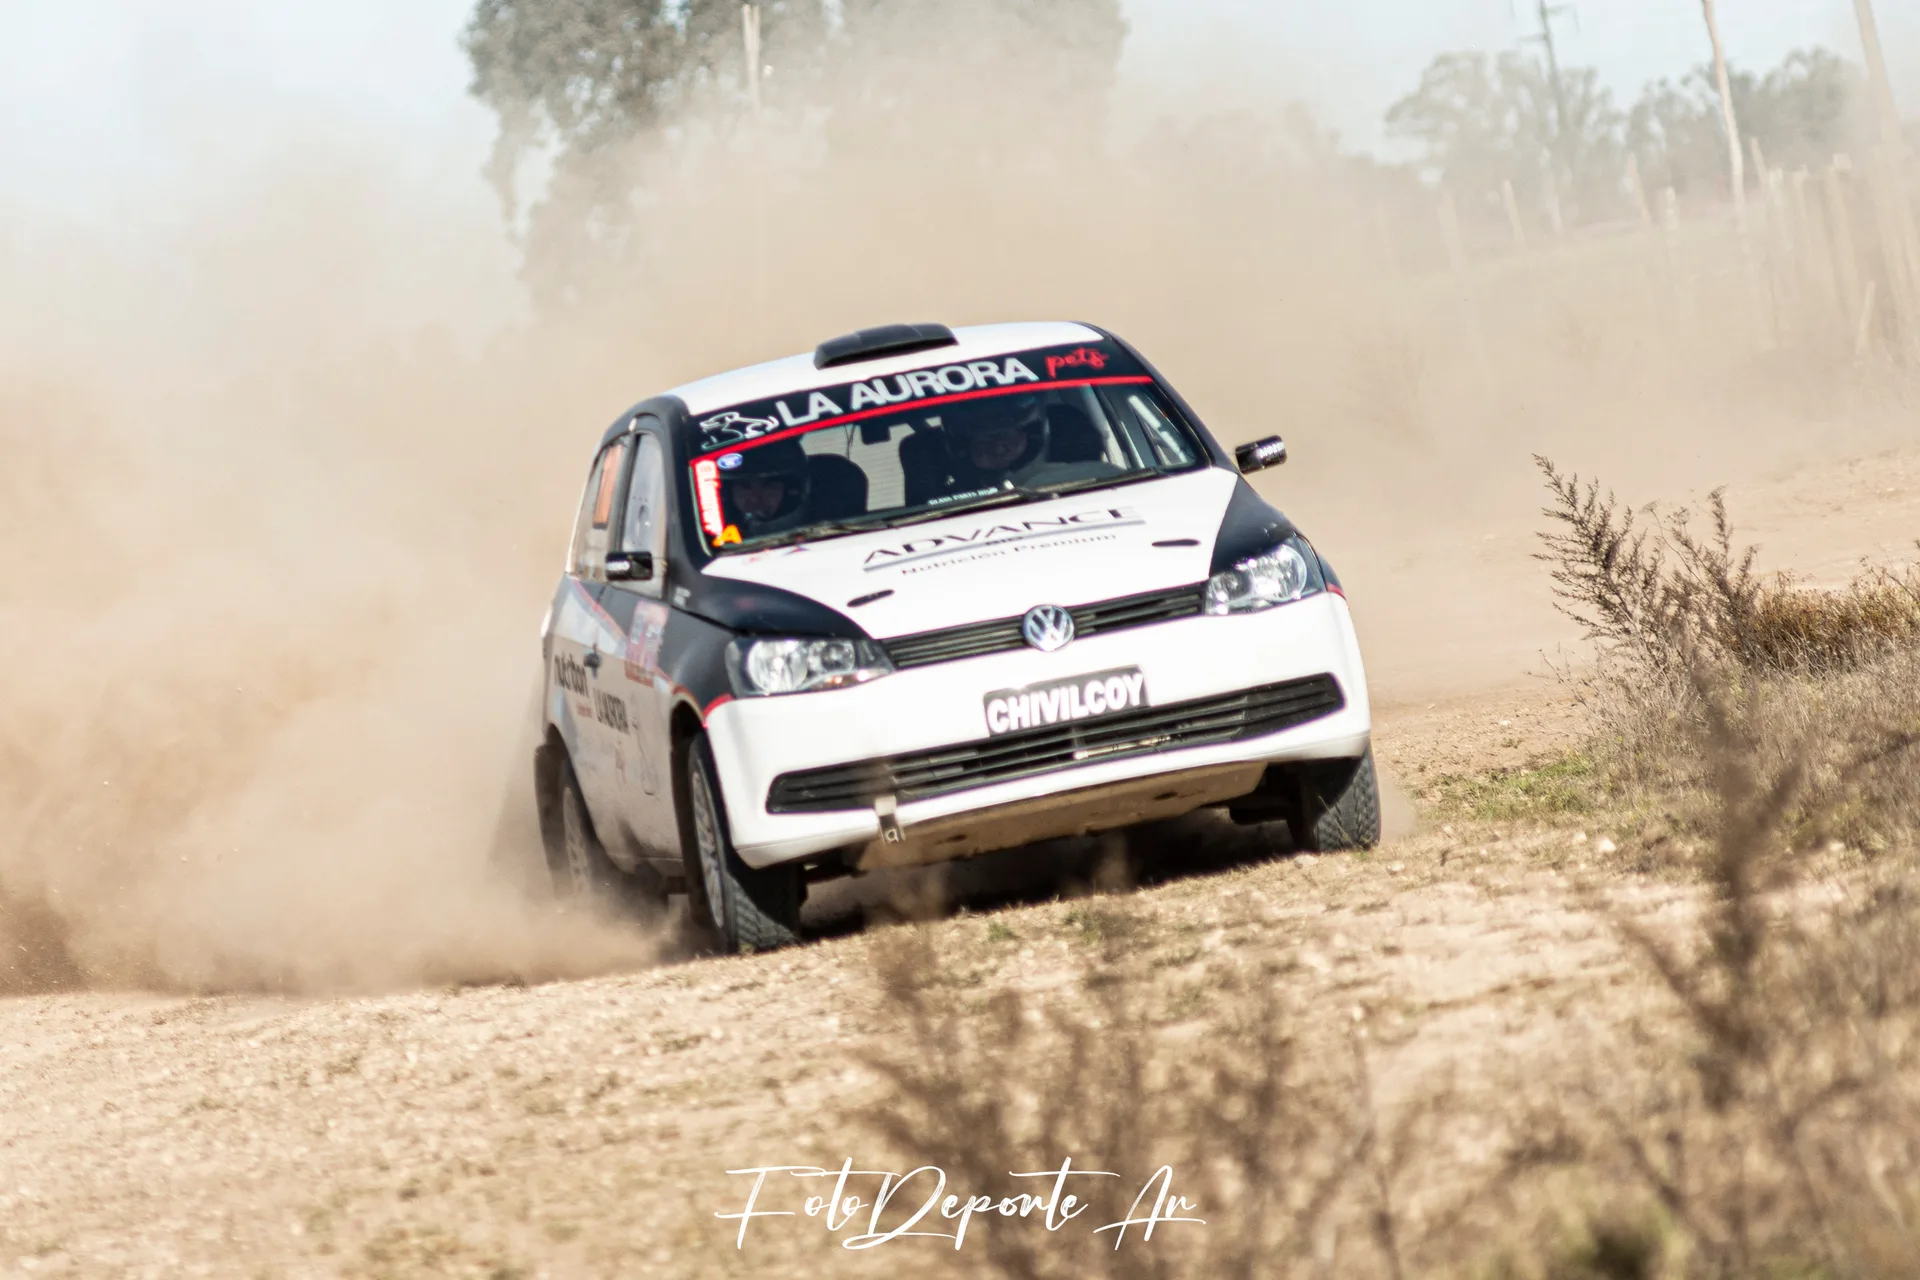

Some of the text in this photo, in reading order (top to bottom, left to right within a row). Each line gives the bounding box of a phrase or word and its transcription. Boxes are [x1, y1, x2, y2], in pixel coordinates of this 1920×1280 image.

[776, 348, 1109, 427] LA AURORA pets
[712, 524, 742, 547] A
[865, 506, 1144, 564] ADVANCE
[1014, 533, 1116, 553] Premium
[987, 672, 1143, 734] CHIVILCOY
